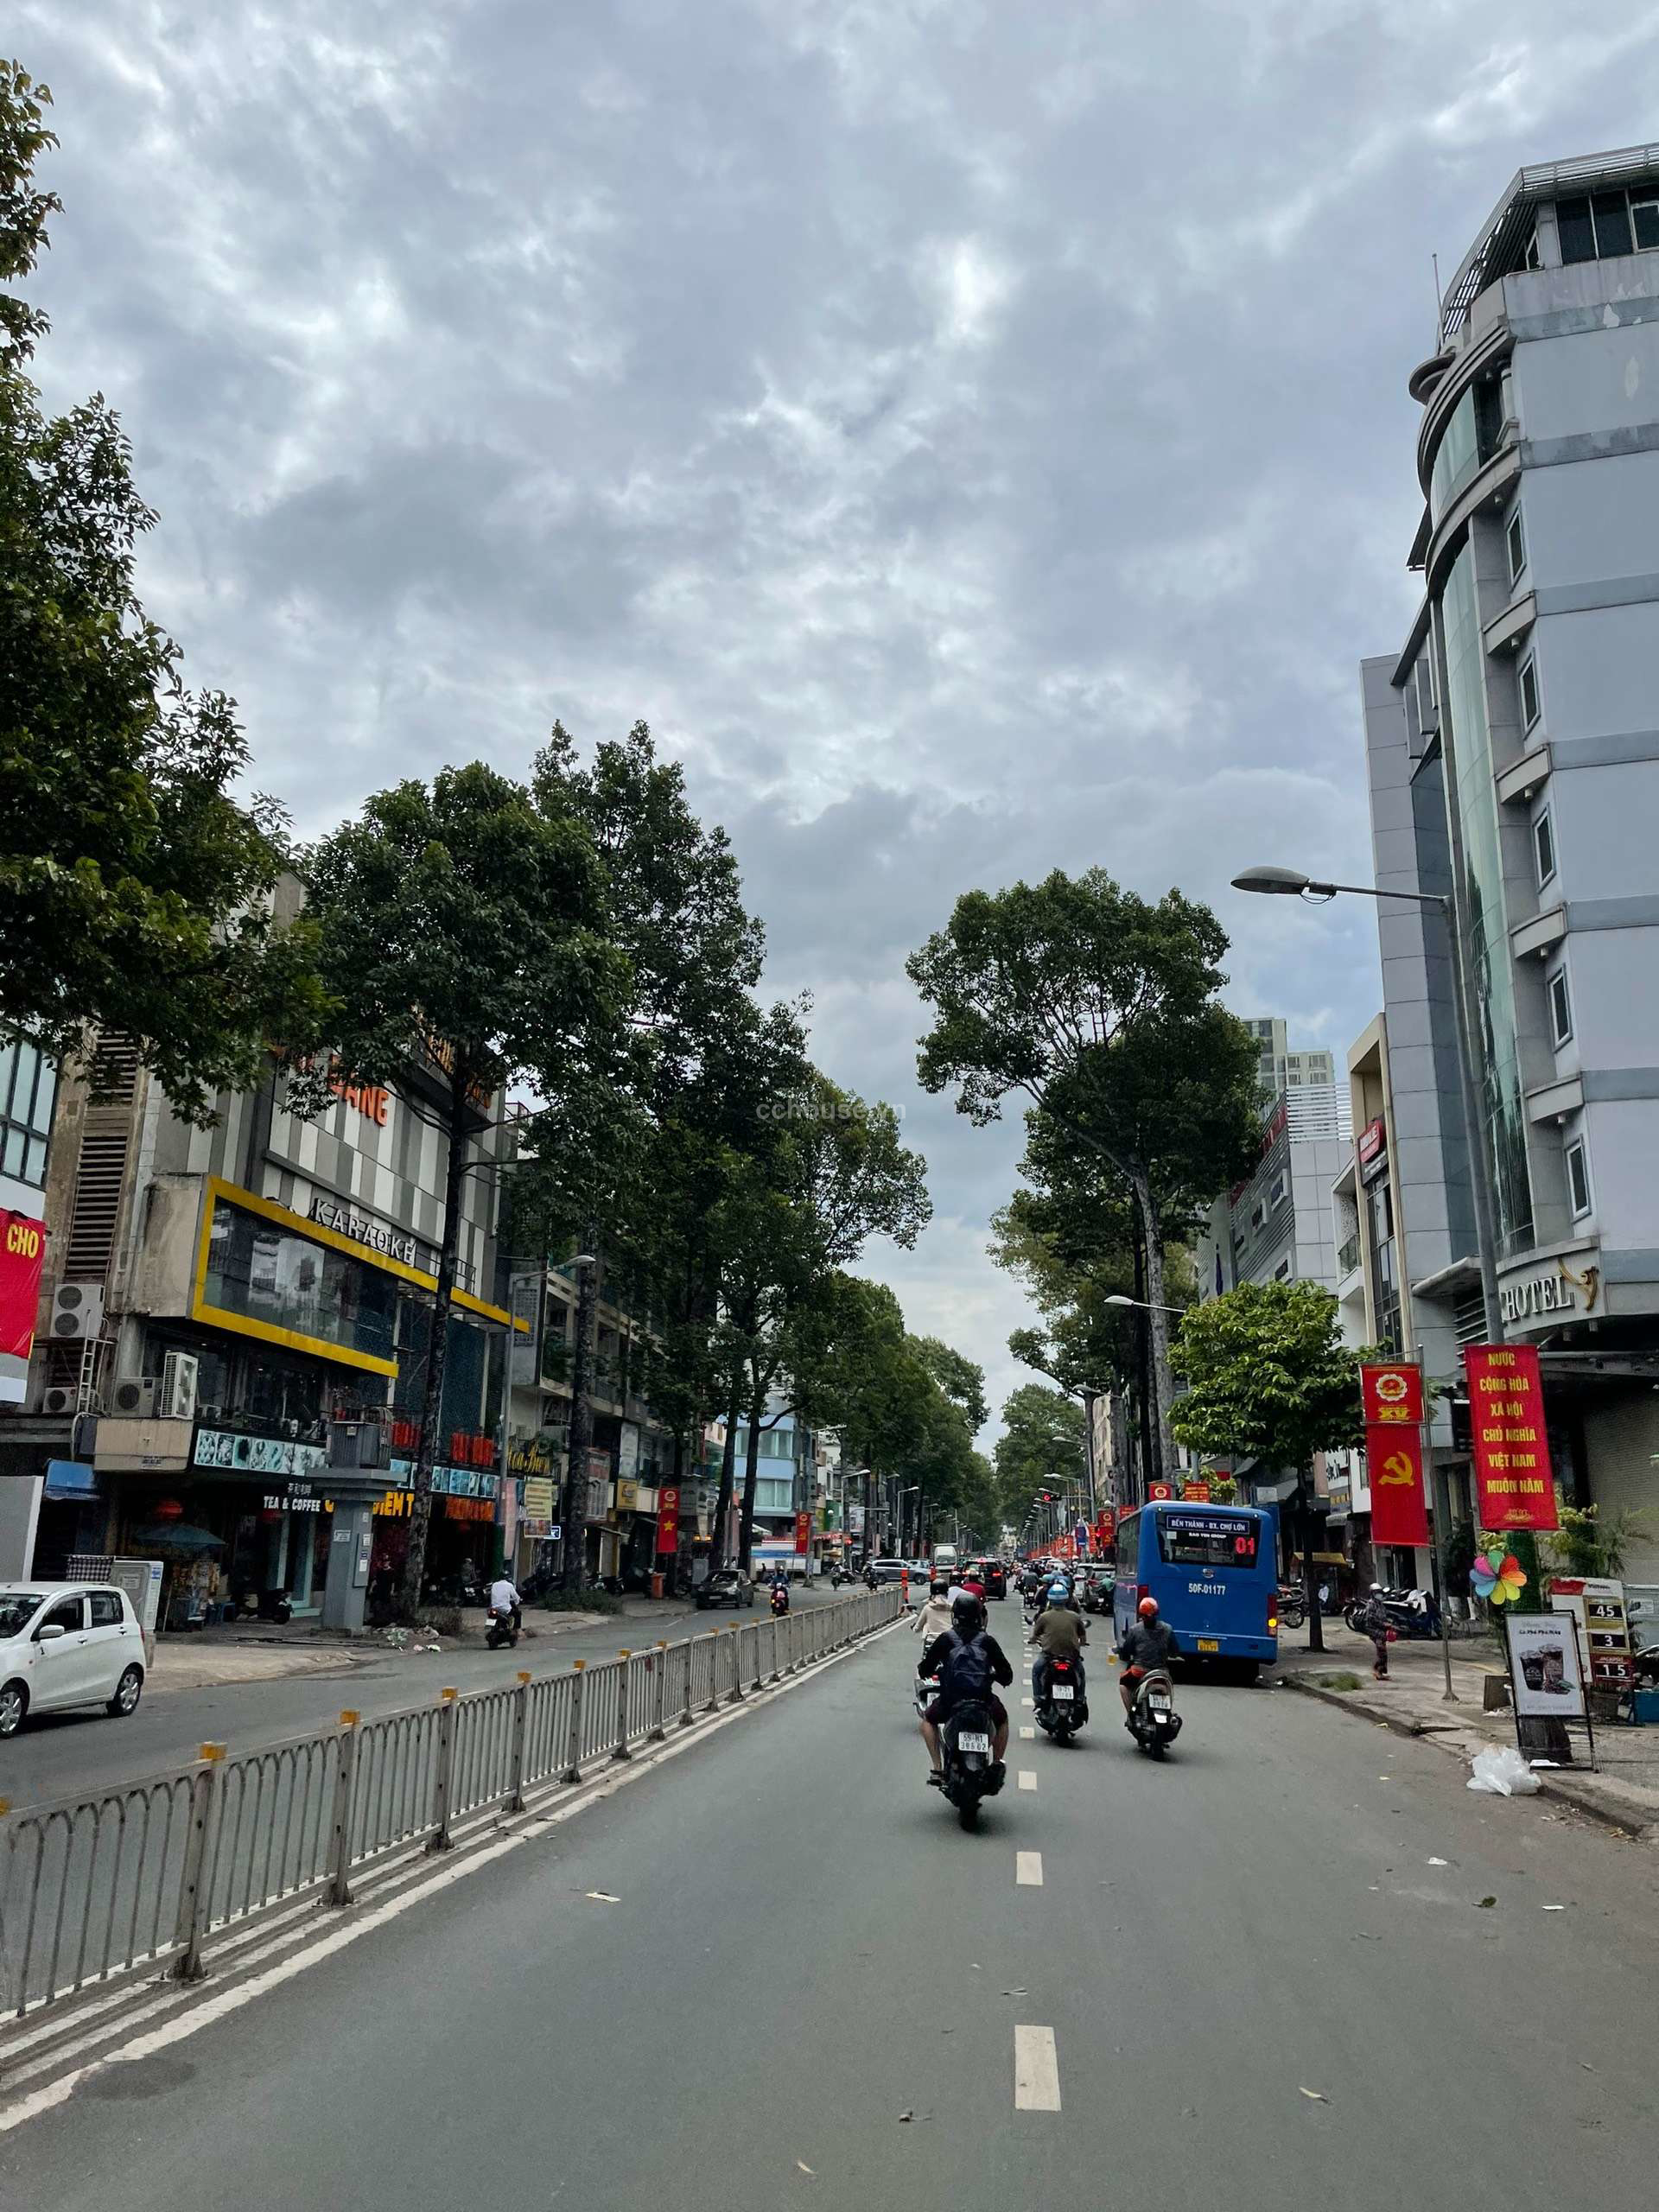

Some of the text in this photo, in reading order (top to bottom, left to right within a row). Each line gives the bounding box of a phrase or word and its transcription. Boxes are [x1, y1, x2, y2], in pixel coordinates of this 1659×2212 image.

[315, 1198, 416, 1268] KARAOKE
[1505, 1274, 1571, 1322] HOTEL
[264, 1496, 279, 1510] TEA
[283, 1497, 289, 1510] &
[292, 1498, 321, 1512] COFFEE
[1235, 1536, 1255, 1555] 01
[1597, 1605, 1615, 1618] 45
[1605, 1635, 1613, 1647] 3
